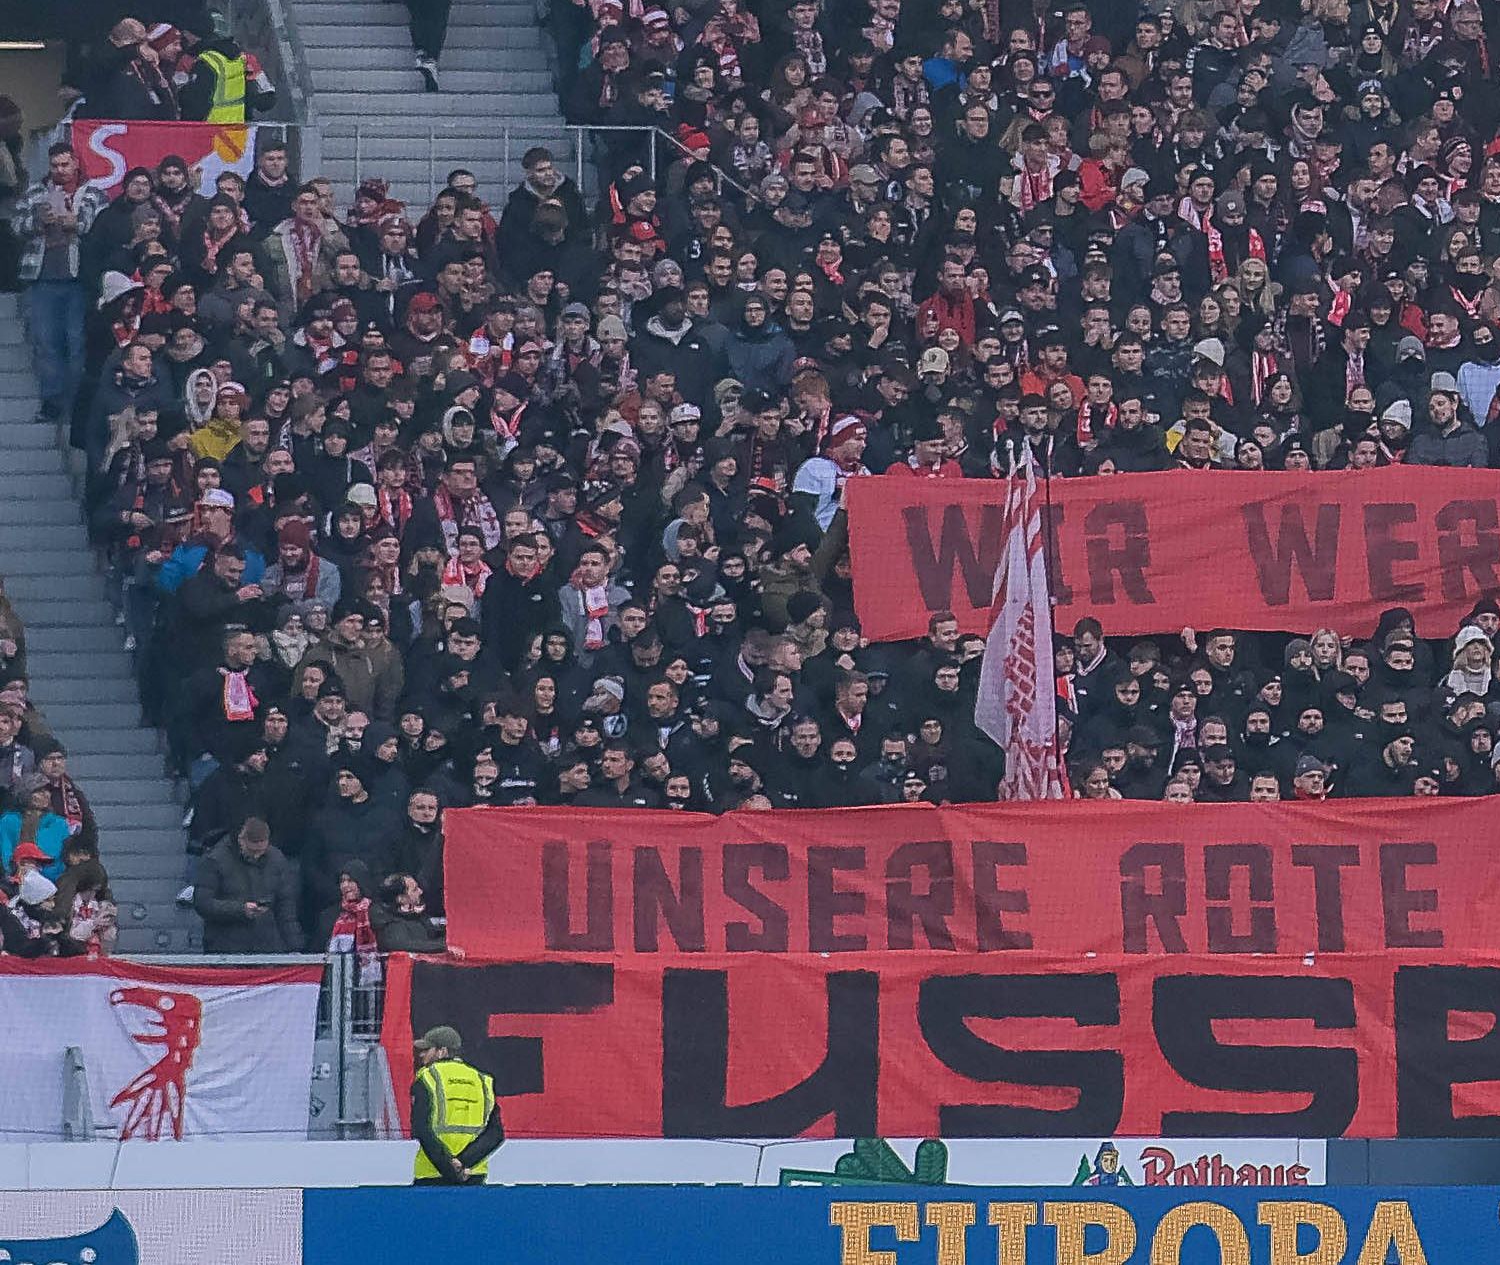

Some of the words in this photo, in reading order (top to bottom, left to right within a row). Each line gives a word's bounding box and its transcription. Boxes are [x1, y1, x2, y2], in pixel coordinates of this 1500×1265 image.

[542, 838, 1034, 955] UNSERE
[1119, 840, 1443, 954] ROTE
[1139, 1147, 1311, 1186] Rothaus
